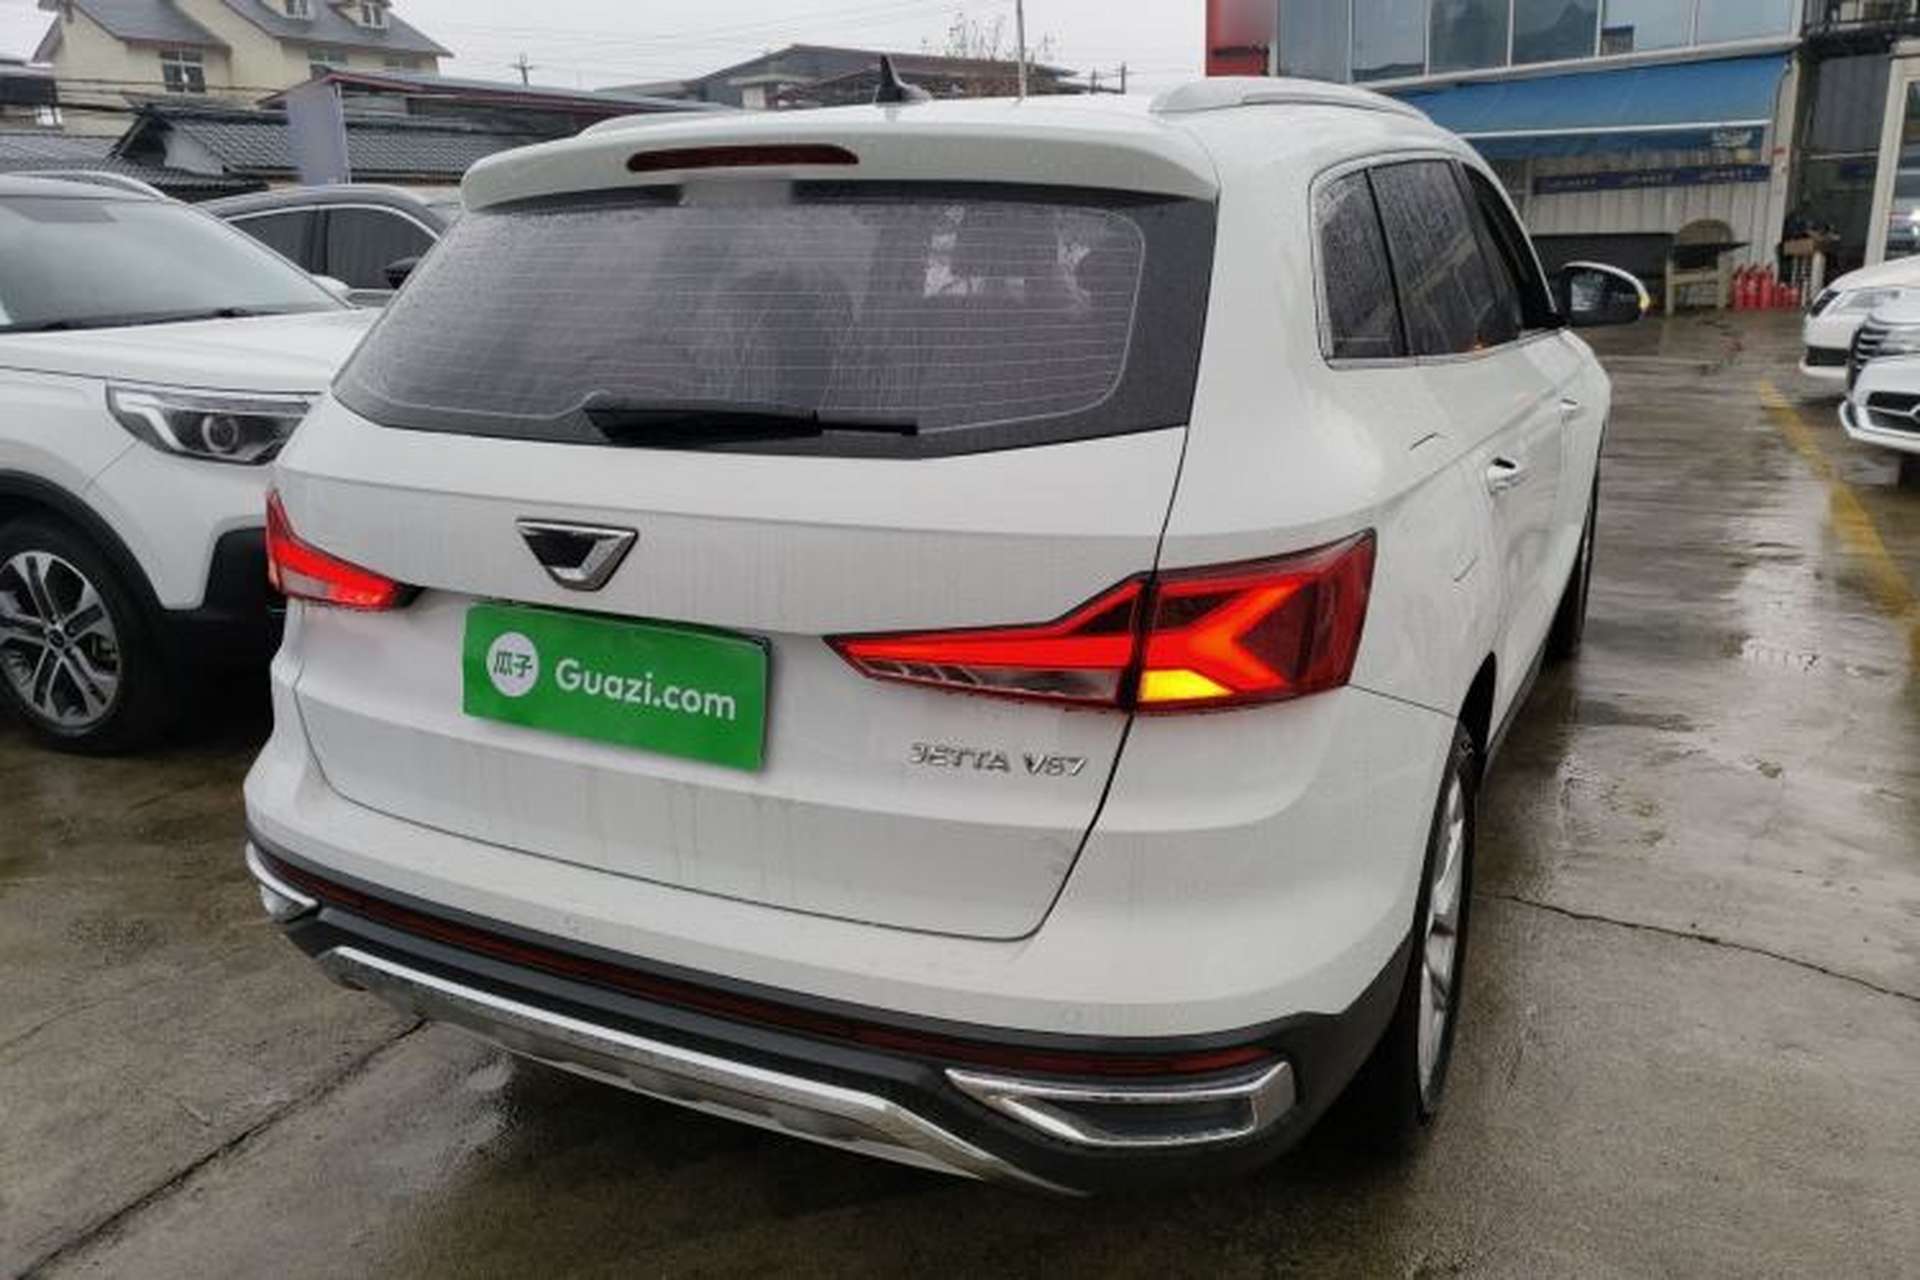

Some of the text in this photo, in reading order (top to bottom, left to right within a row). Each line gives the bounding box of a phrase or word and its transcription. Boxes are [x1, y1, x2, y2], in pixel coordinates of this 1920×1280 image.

[493, 650, 736, 721] 瓜子 Guazi.com
[910, 742, 1011, 773] JETTA
